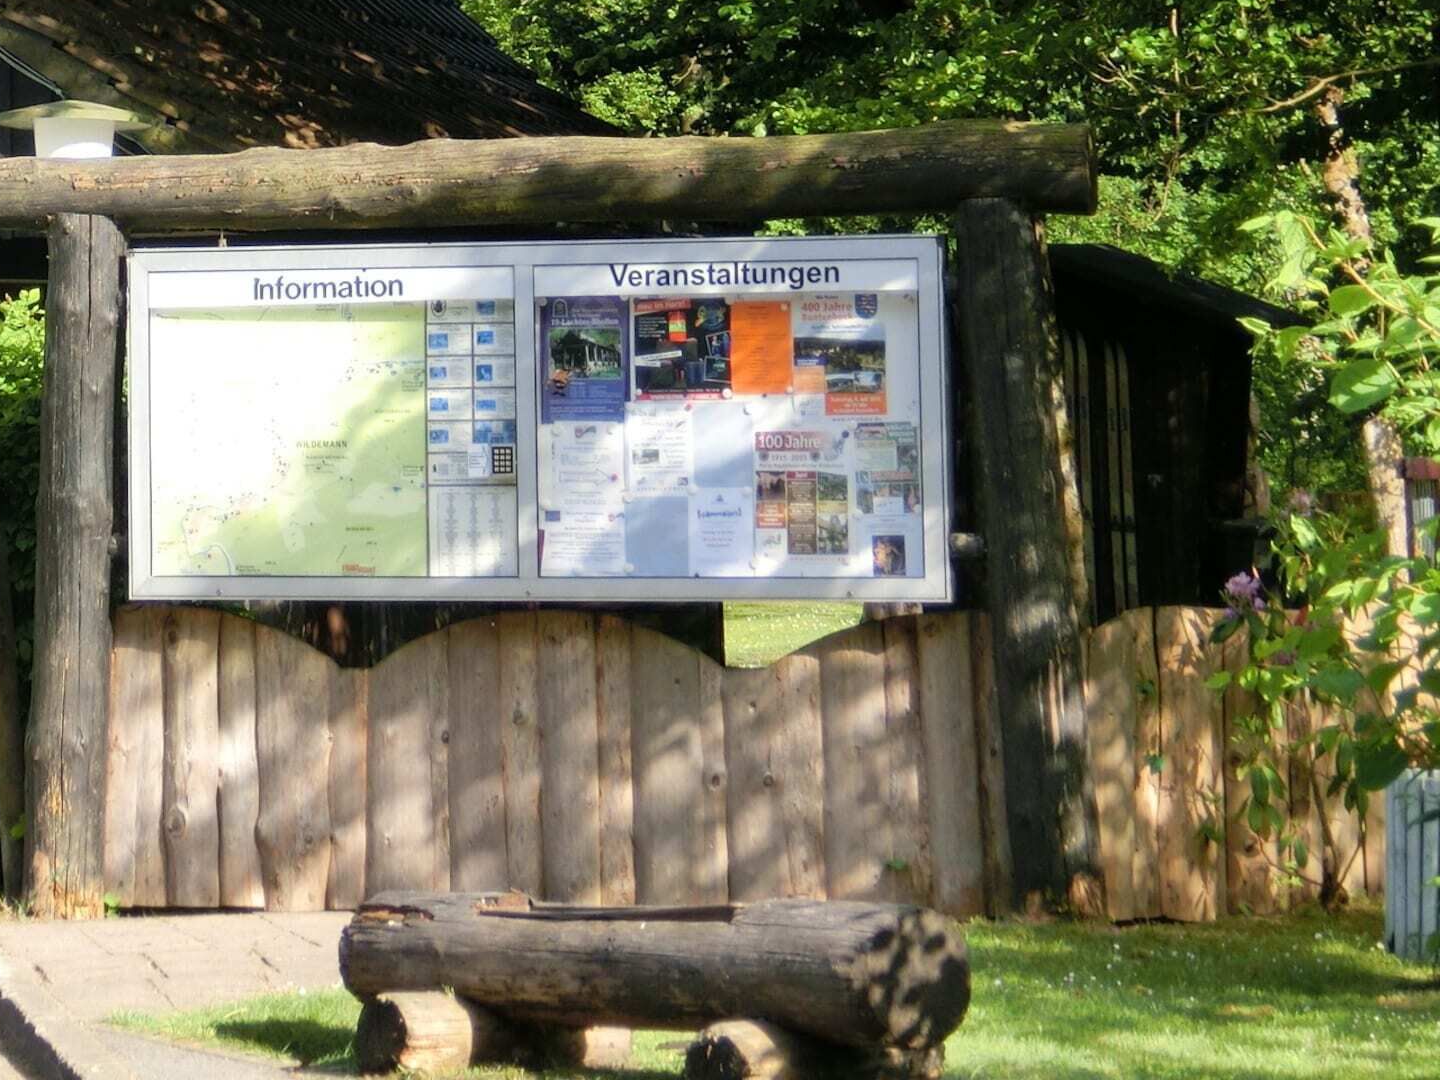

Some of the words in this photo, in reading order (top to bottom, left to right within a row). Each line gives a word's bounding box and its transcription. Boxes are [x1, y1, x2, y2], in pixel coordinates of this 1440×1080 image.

[609, 262, 841, 290] Veranstaltungen
[253, 276, 404, 301] Information
[296, 440, 348, 449] WILDEMANN
[758, 434, 783, 449] 100
[785, 434, 820, 449] Jahre
